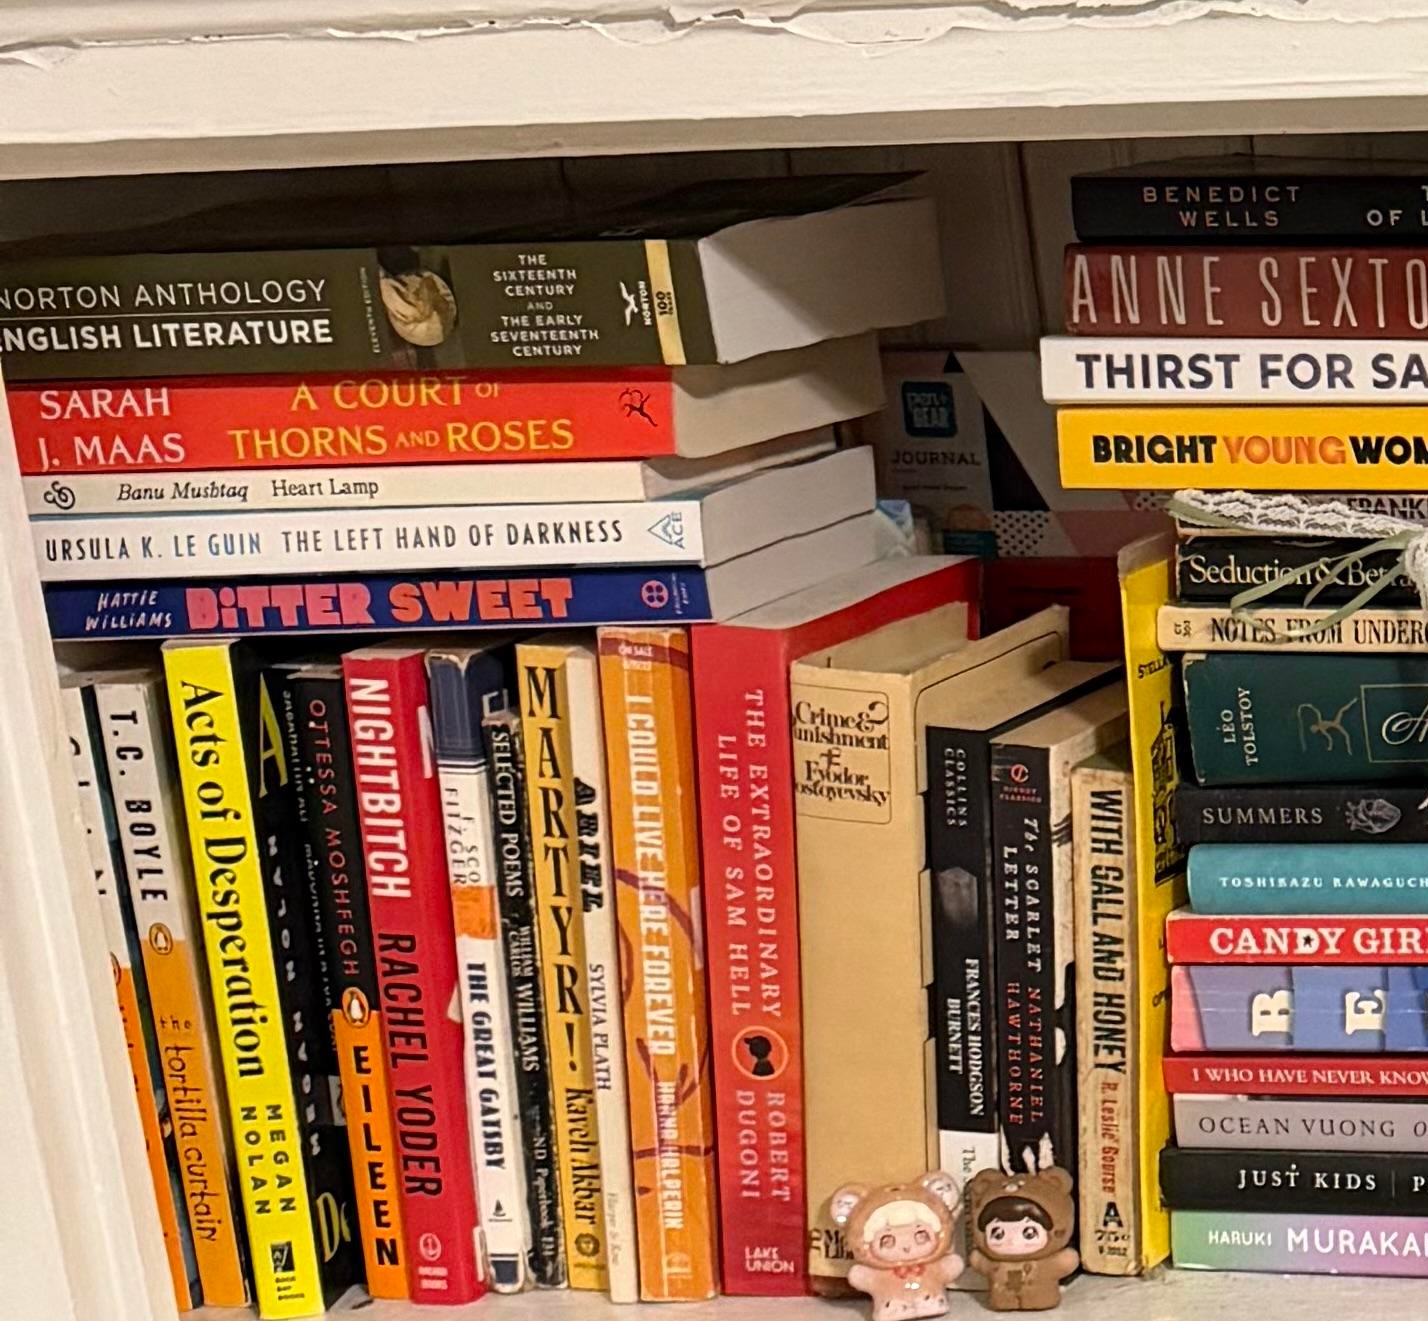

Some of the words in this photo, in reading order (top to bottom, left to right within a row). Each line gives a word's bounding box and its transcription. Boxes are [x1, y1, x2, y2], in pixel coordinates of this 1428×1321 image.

[493, 269, 577, 282] SIXTEENTH
[1072, 253, 1224, 326] ANNE
[134, 279, 326, 306] ANTHOLOGY
[505, 285, 575, 297] CENTURY
[133, 320, 333, 349] LITERATURE
[536, 315, 583, 326] EARLY
[490, 329, 600, 343] SEVENTEENTH
[512, 345, 582, 357] CENTURY
[1076, 352, 1240, 390] THIRST
[39, 388, 170, 419] SARAH
[75, 434, 185, 464] MAAS
[229, 426, 388, 460] THORNS
[448, 420, 574, 453] ROSES
[1092, 435, 1216, 464] BRIGHT
[117, 481, 164, 501] Banu
[170, 481, 249, 503] Mushtaq
[272, 478, 324, 498] Heart
[330, 477, 379, 499] Lamp
[45, 537, 129, 562] URSULA
[208, 532, 262, 555] GUIN
[389, 579, 573, 622] SWEET
[349, 678, 411, 898] NIGHTBITCH
[1203, 805, 1323, 825] SUMMERS
[180, 681, 225, 768] Acts
[204, 836, 268, 1079] Desperation
[525, 666, 583, 1073] MARTYR!
[747, 764, 782, 1018] EXTRAORDINARY
[1210, 928, 1347, 956] CANDY
[378, 932, 430, 1069] RACHEL
[589, 963, 609, 1022] SYLVIA
[590, 1029, 612, 1092] PLATH
[395, 1086, 443, 1198] YODER
